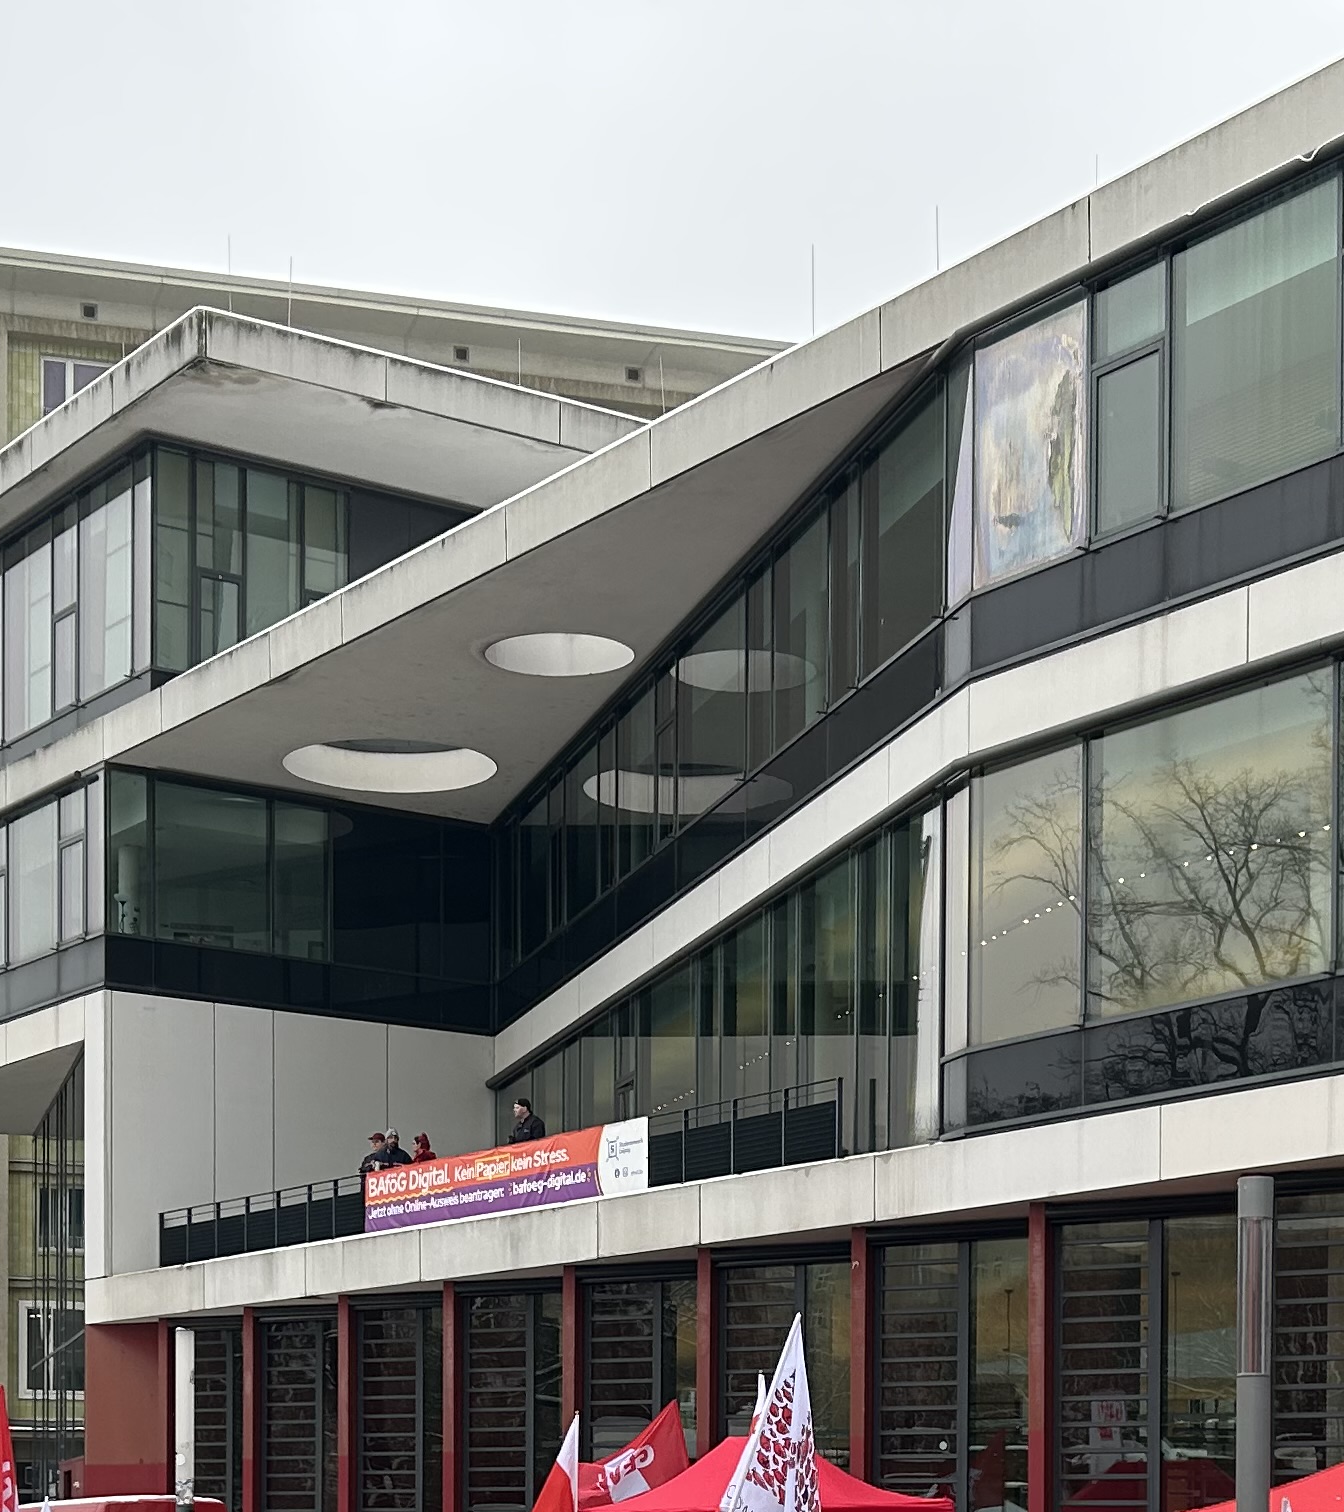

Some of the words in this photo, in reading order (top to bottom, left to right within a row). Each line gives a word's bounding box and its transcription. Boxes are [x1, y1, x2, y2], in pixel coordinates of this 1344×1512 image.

[368, 1172, 407, 1198] BAföG
[454, 1163, 476, 1182] Kein
[510, 1153, 533, 1172] kein
[368, 1205, 387, 1219] Jetzt
[386, 1204, 404, 1217] ohne
